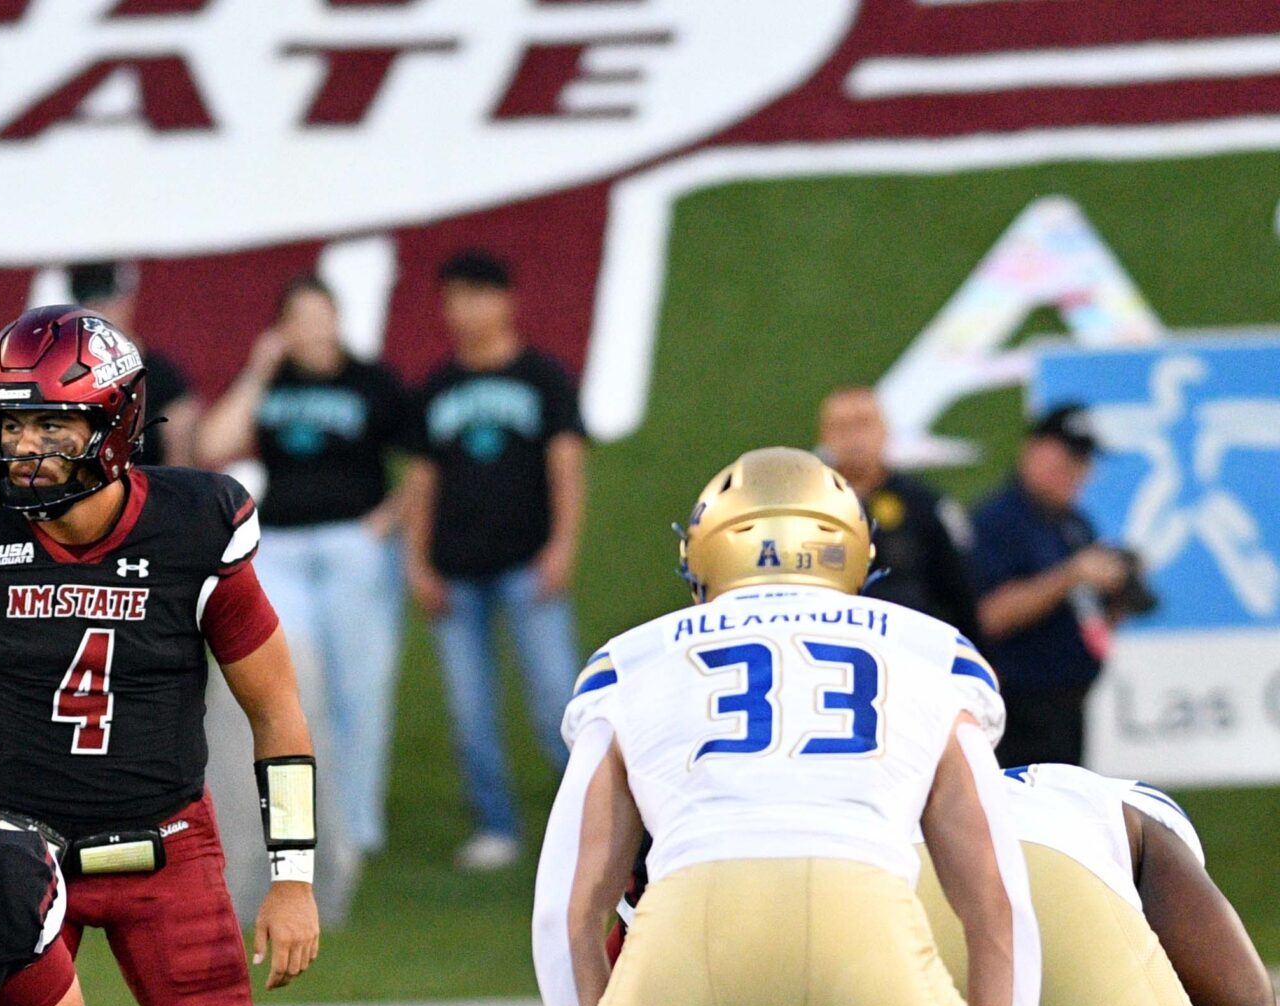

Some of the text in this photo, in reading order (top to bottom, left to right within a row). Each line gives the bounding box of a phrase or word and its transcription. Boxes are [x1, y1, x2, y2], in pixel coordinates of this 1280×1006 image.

[6, 584, 150, 621] NM STATE
[51, 627, 115, 755] 4
[688, 635, 885, 770] 33
